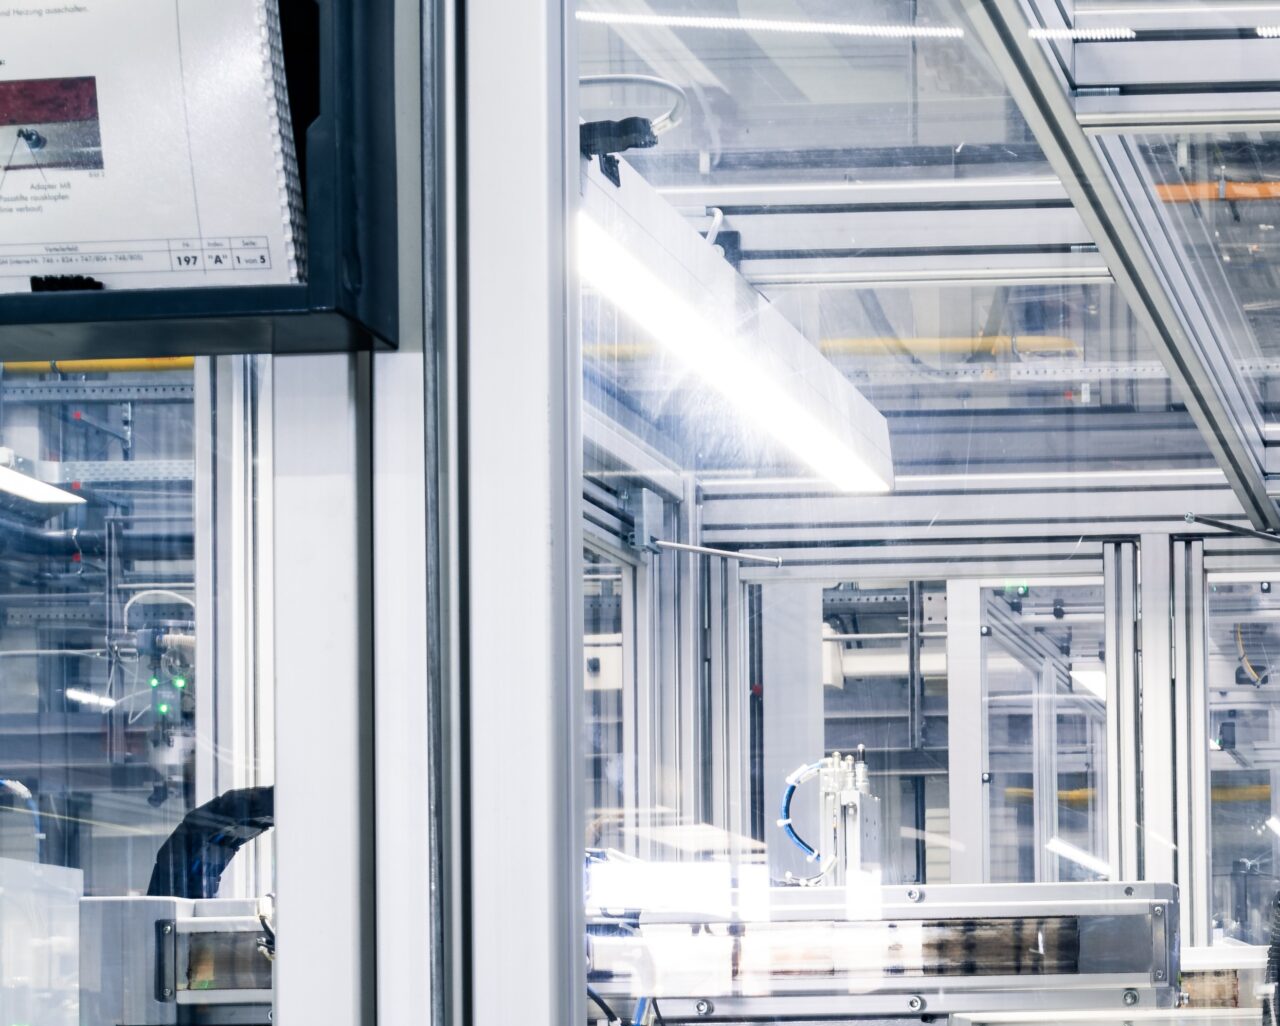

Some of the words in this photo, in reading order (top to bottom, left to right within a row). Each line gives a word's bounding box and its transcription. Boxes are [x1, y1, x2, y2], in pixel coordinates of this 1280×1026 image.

[13, 8, 43, 18] Heizung
[177, 255, 198, 266] 197
[208, 254, 228, 264] "A"
[236, 256, 241, 264] 1
[260, 255, 266, 264] 5
